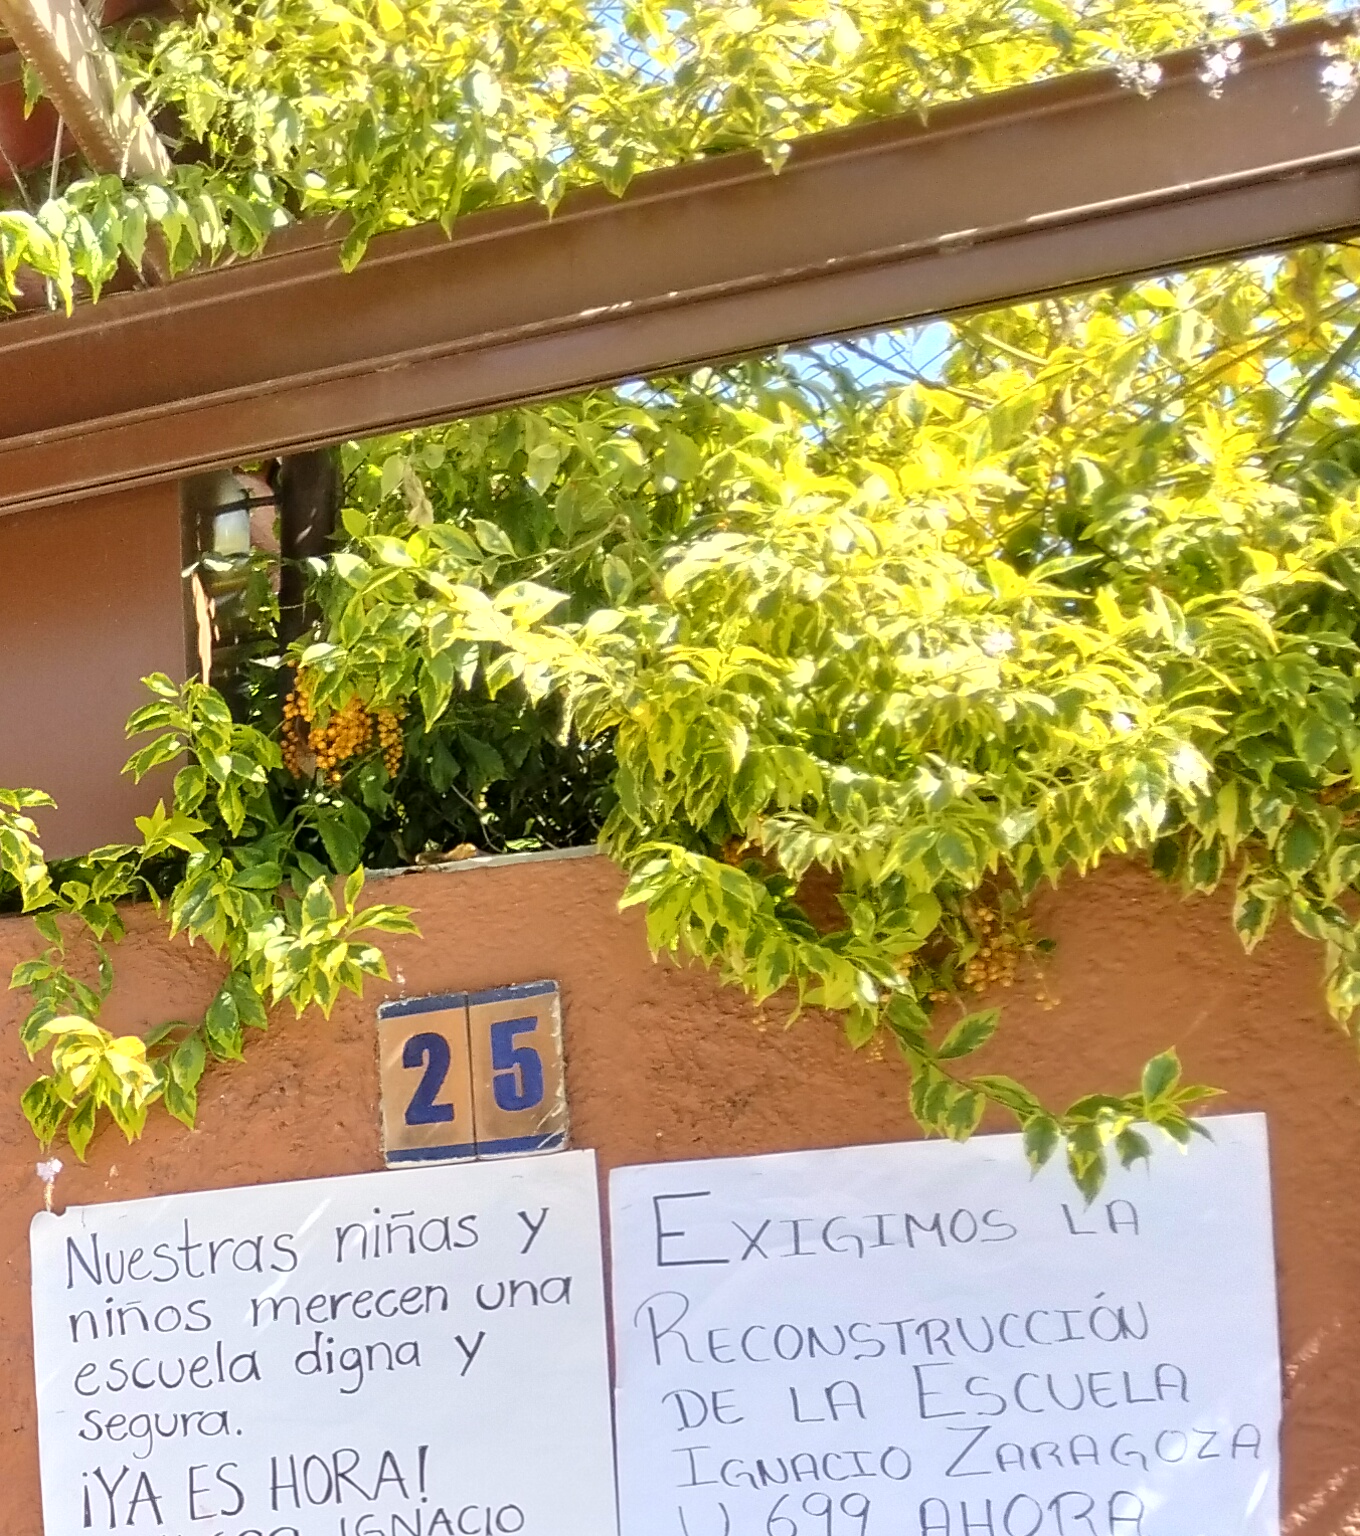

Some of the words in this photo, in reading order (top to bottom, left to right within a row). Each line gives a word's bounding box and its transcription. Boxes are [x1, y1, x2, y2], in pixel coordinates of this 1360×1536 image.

[65, 1218, 298, 1289] Nuestras
[335, 1207, 479, 1263] niñas
[1060, 1198, 1140, 1237] LA
[69, 1298, 213, 1343] niños
[250, 1284, 449, 1329] merecen
[476, 1274, 572, 1310] una
[633, 1290, 1149, 1366] RECONSTRUCCIÓN
[74, 1341, 262, 1397] escuela
[295, 1330, 421, 1394] digna
[661, 1387, 744, 1431] DE
[789, 1380, 867, 1422] LA
[912, 1361, 1190, 1419] ESCUELA
[78, 1408, 243, 1460] segura.
[673, 1444, 913, 1488] IGNACIO
[944, 1422, 1263, 1477] ZARAGOZA
[82, 1465, 164, 1529] ¡YA
[188, 1462, 245, 1520] ES
[270, 1445, 429, 1512] HORA!
